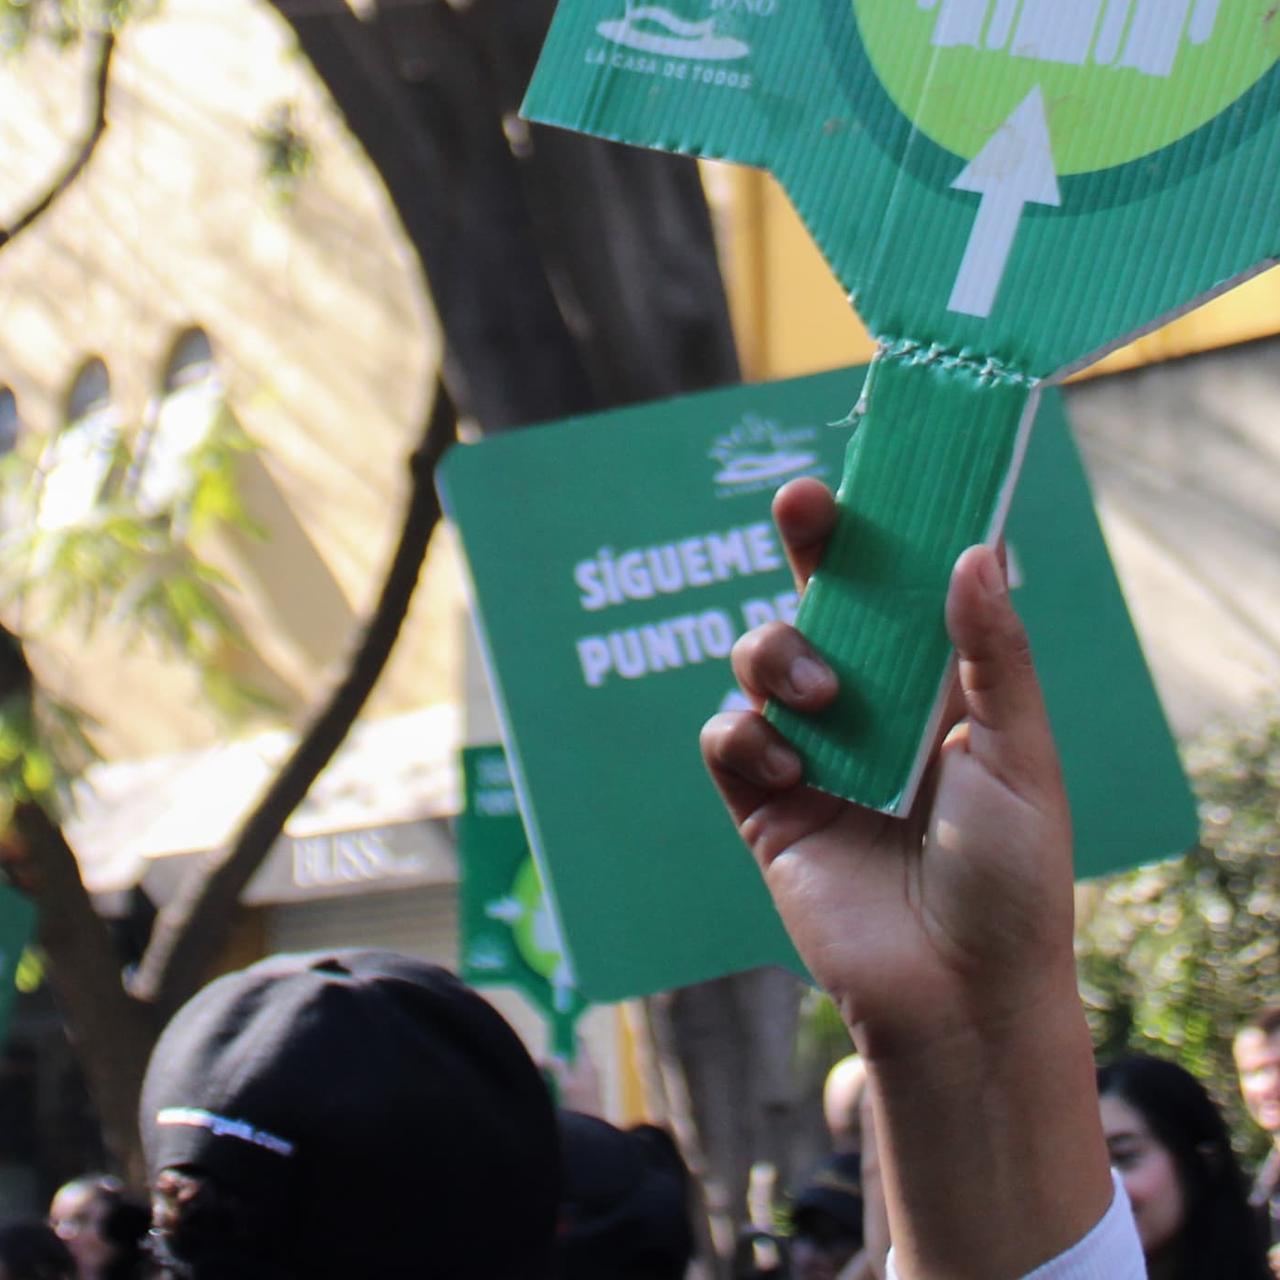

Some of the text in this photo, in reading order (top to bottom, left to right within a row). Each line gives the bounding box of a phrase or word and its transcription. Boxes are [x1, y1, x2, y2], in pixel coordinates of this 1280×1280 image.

[611, 55, 656, 75] CASA
[663, 61, 687, 80] DE
[692, 66, 753, 90] TODOS
[574, 521, 782, 611] SÍGUEME
[577, 607, 736, 688] PUNTO
